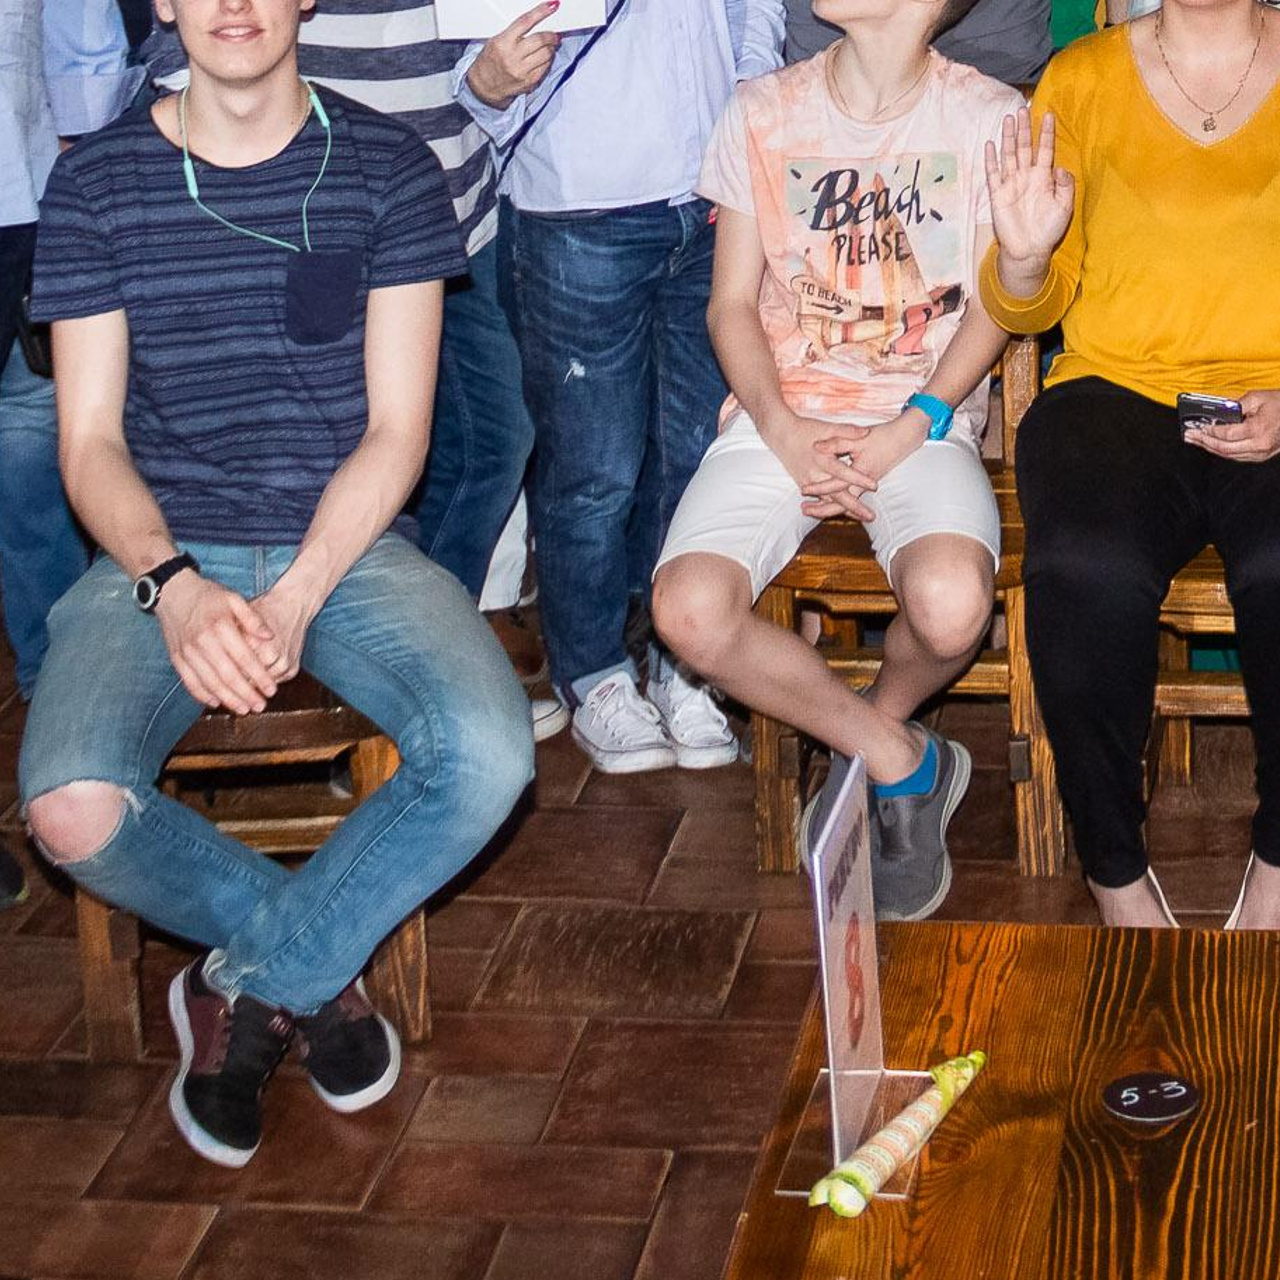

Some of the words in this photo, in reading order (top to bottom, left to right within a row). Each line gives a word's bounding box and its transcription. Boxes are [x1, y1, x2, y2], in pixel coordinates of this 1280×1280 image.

[809, 159, 926, 231] Beach
[831, 231, 912, 266] PLEASE
[801, 282, 815, 296] TO
